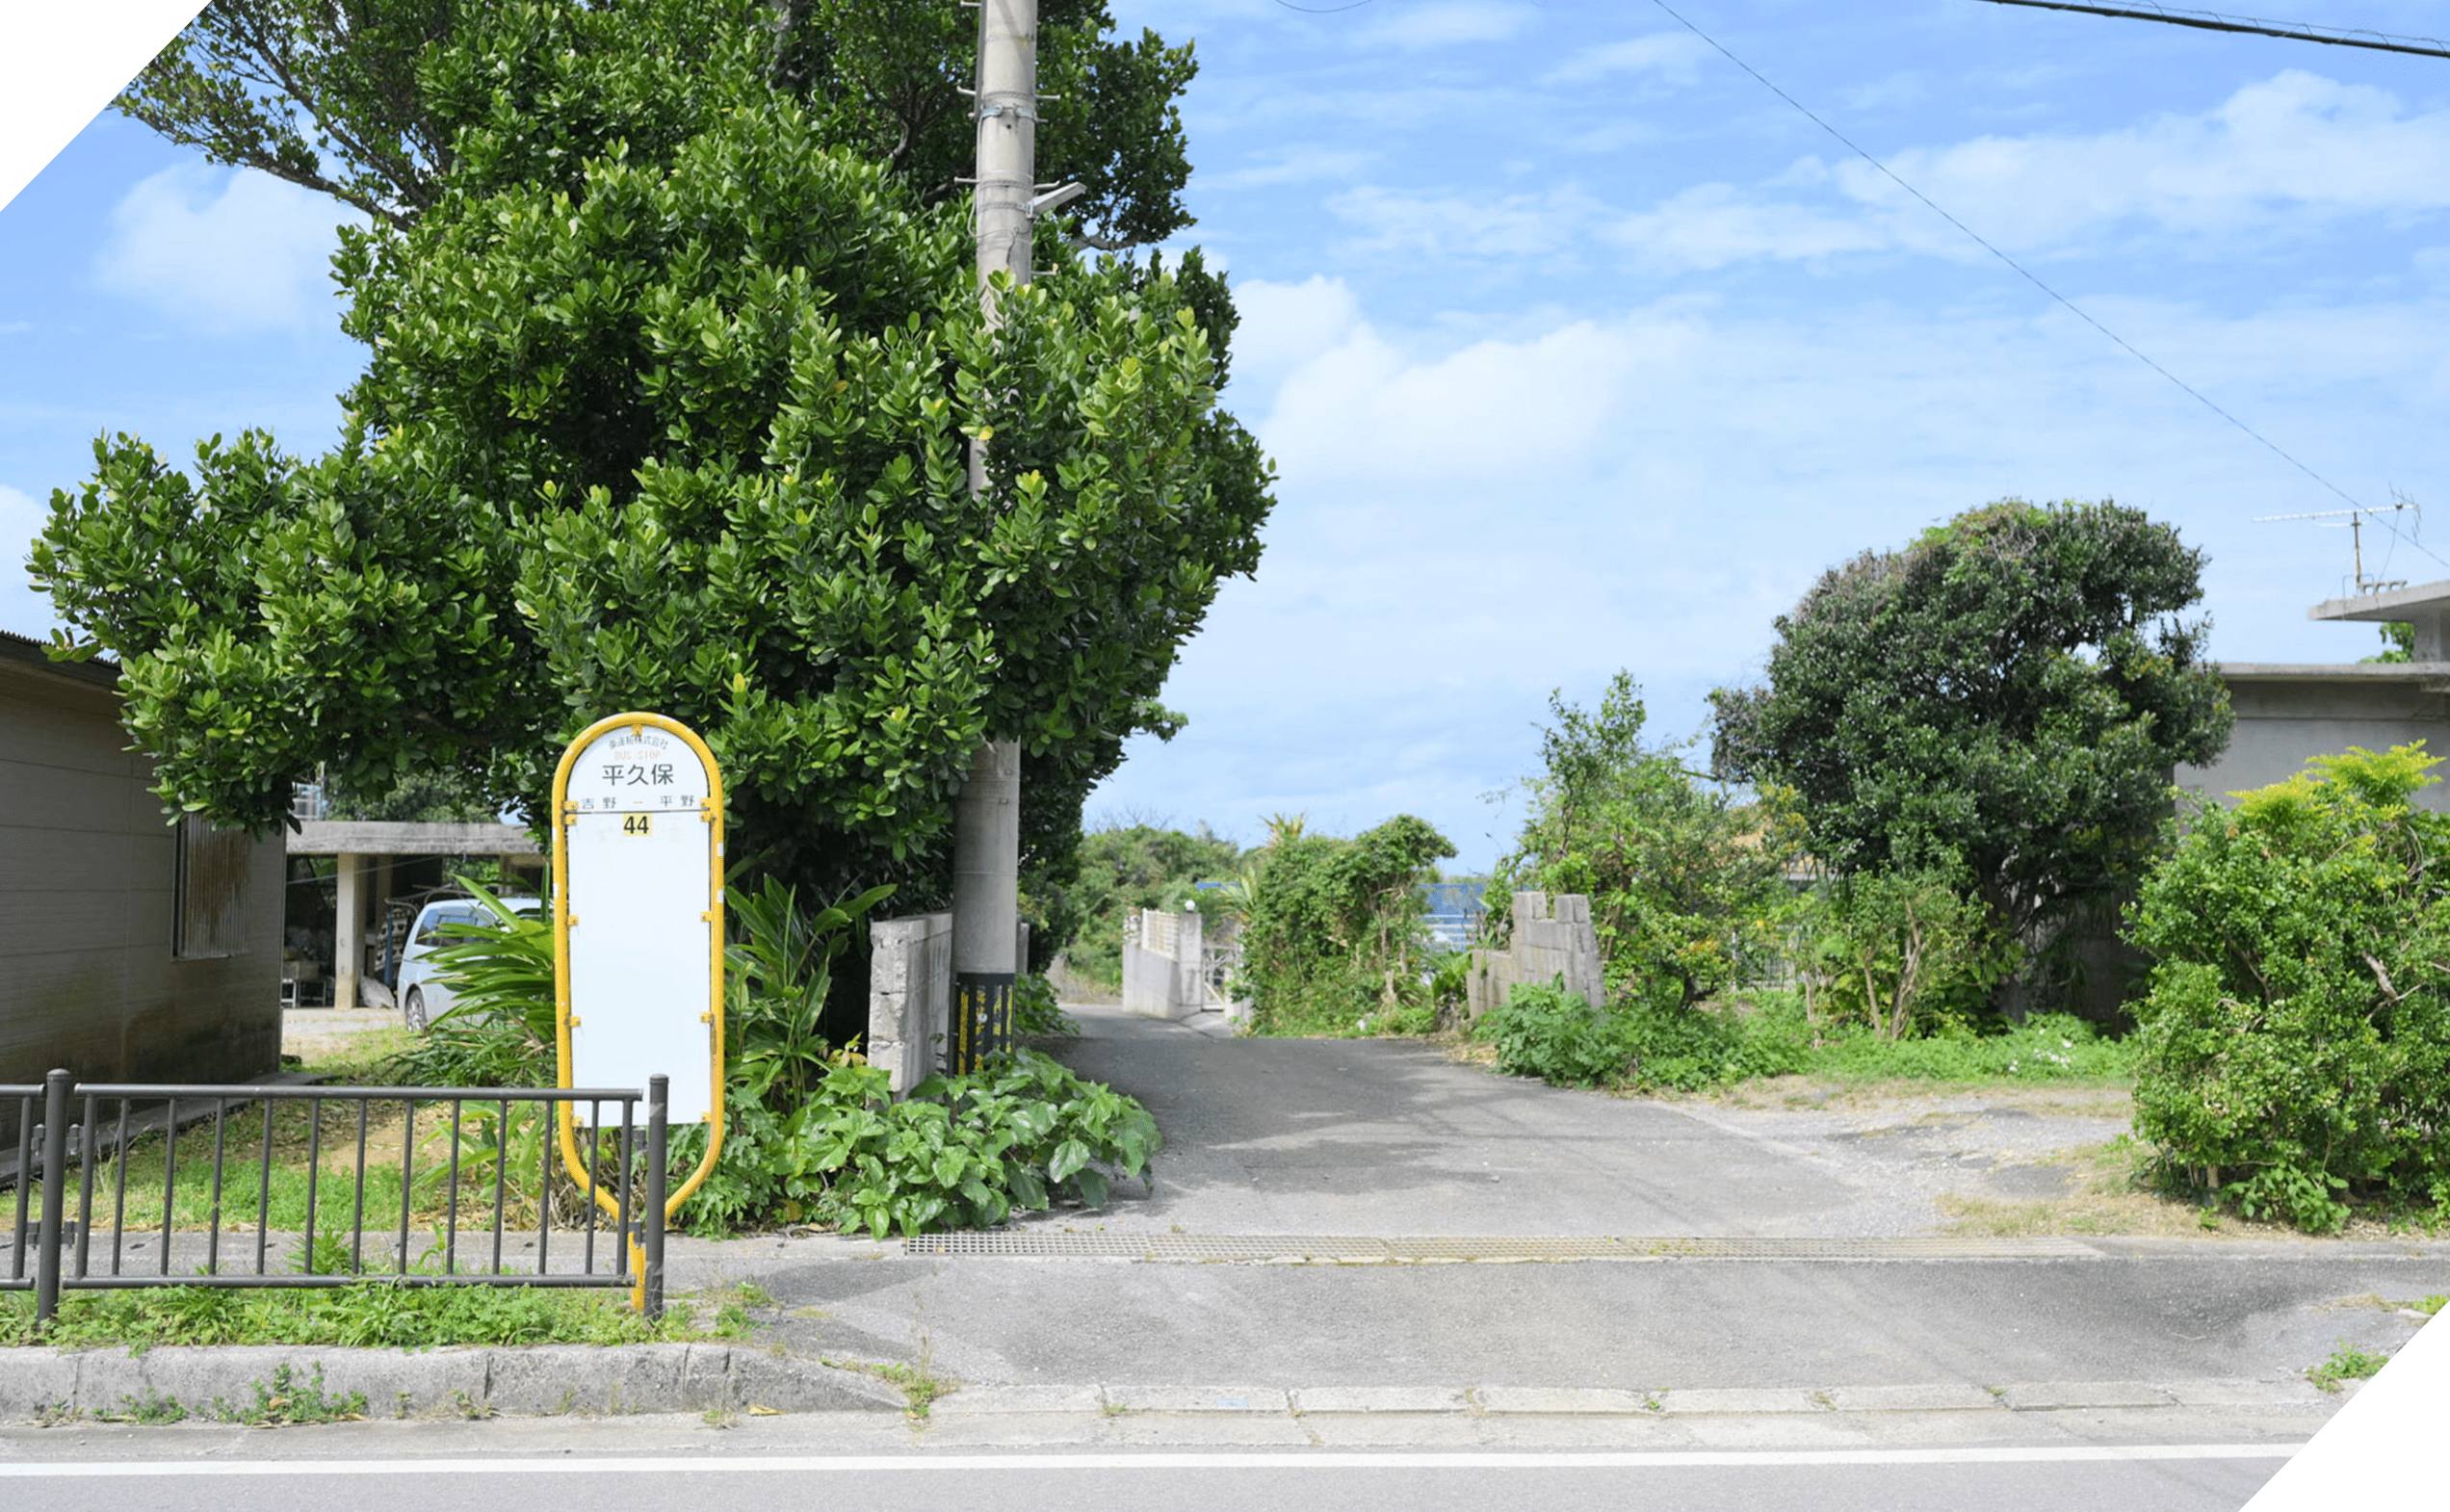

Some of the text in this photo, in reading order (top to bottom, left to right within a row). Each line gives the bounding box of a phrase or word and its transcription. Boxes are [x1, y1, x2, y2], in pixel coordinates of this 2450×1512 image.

[613, 749, 662, 761] BUS STOP
[602, 764, 674, 786] 平久保
[660, 795, 694, 807] 平野
[623, 816, 649, 834] 44
